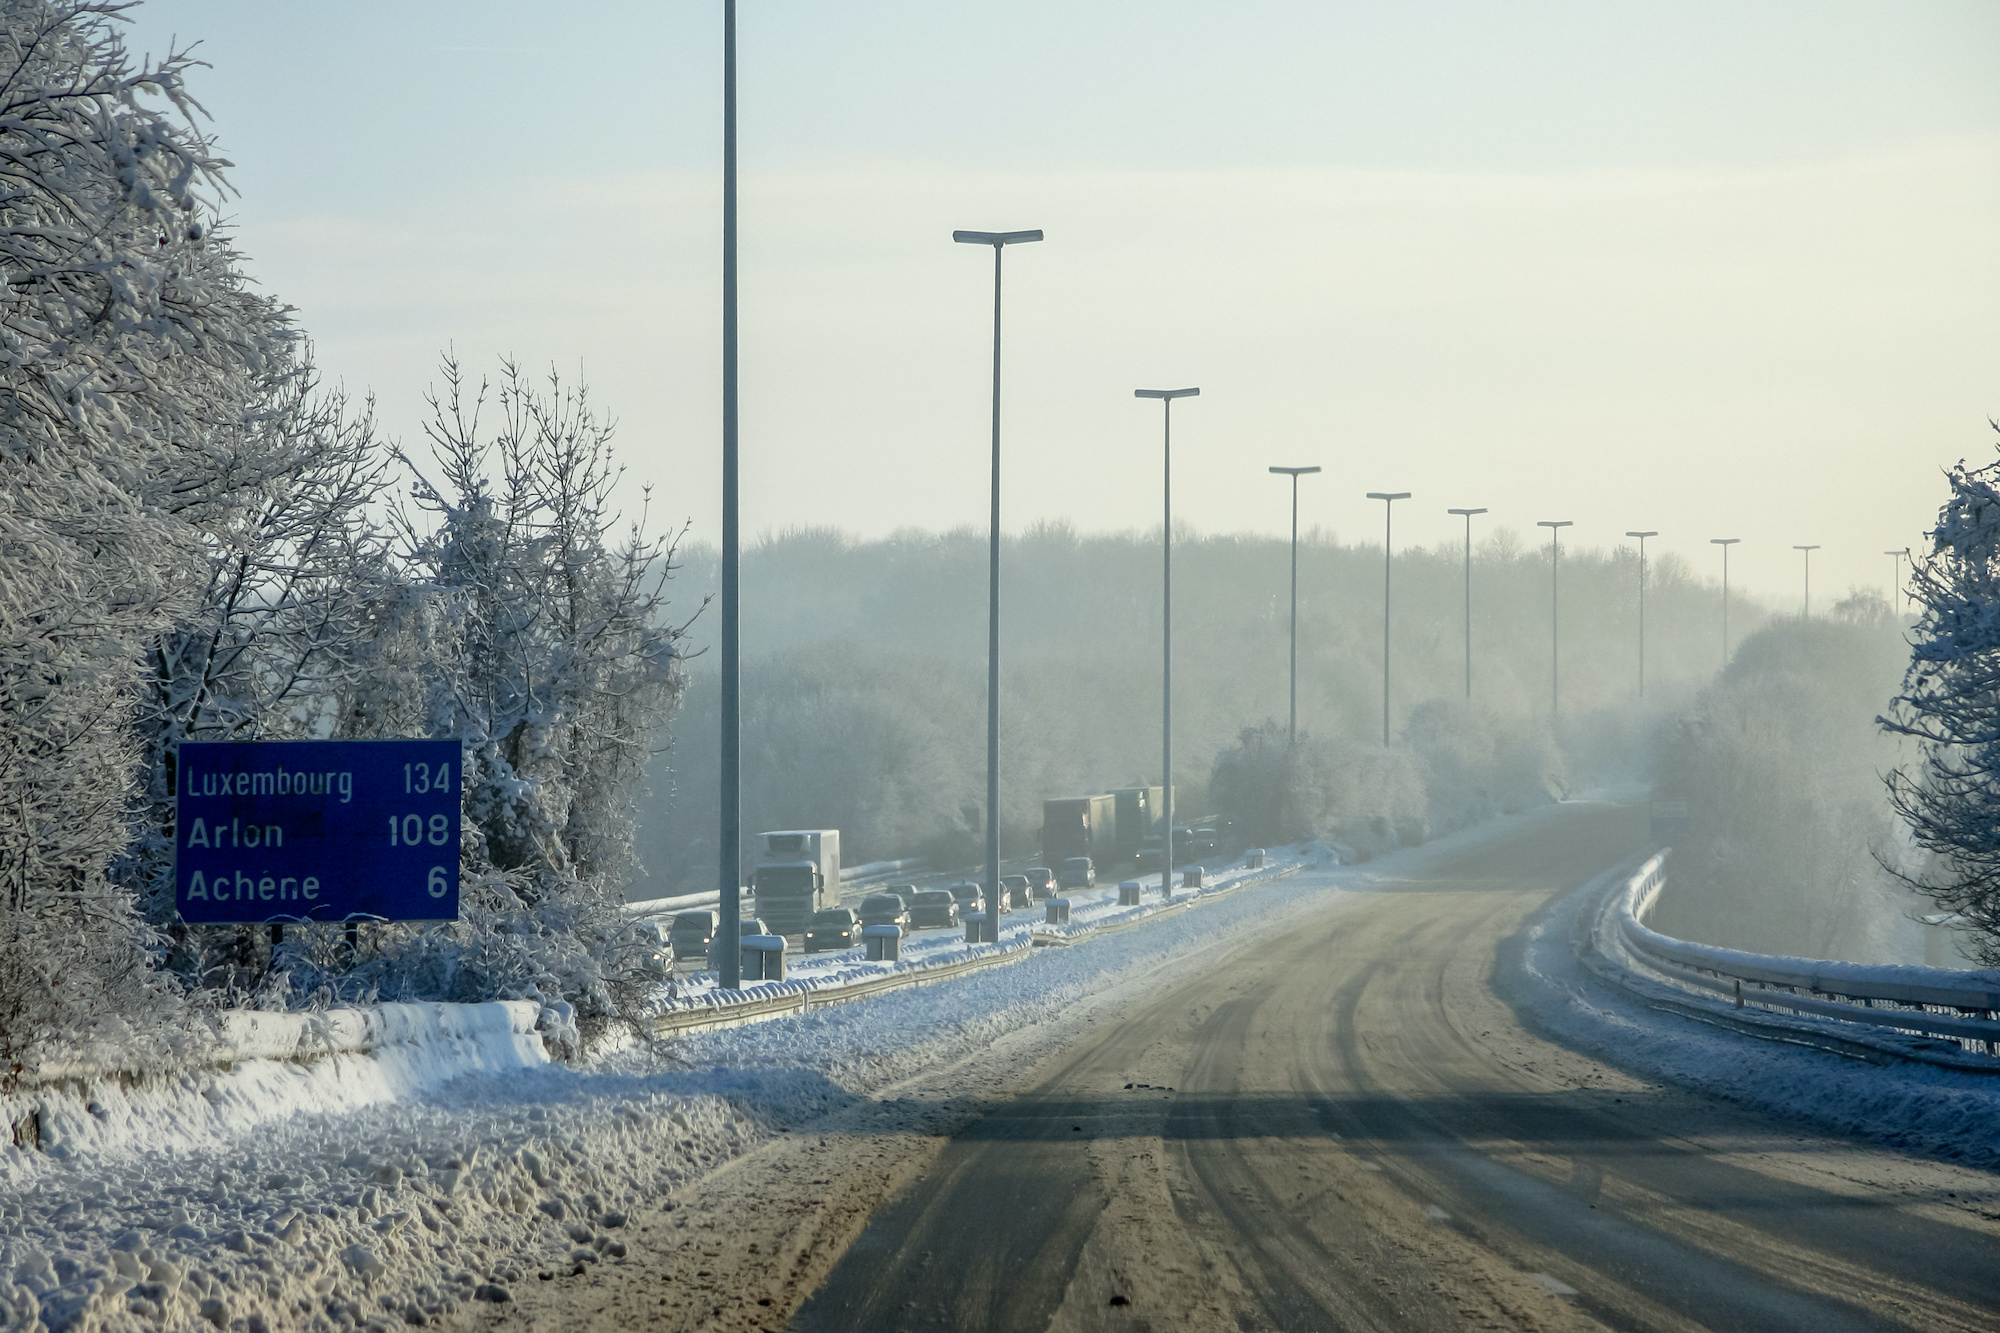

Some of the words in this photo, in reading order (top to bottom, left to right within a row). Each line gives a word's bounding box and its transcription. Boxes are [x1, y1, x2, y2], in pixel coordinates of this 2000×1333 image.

[187, 764, 352, 803] Luxembourg
[404, 762, 450, 794] 134
[187, 816, 283, 848] Arlon
[388, 813, 450, 847] 108
[427, 866, 448, 899] 6
